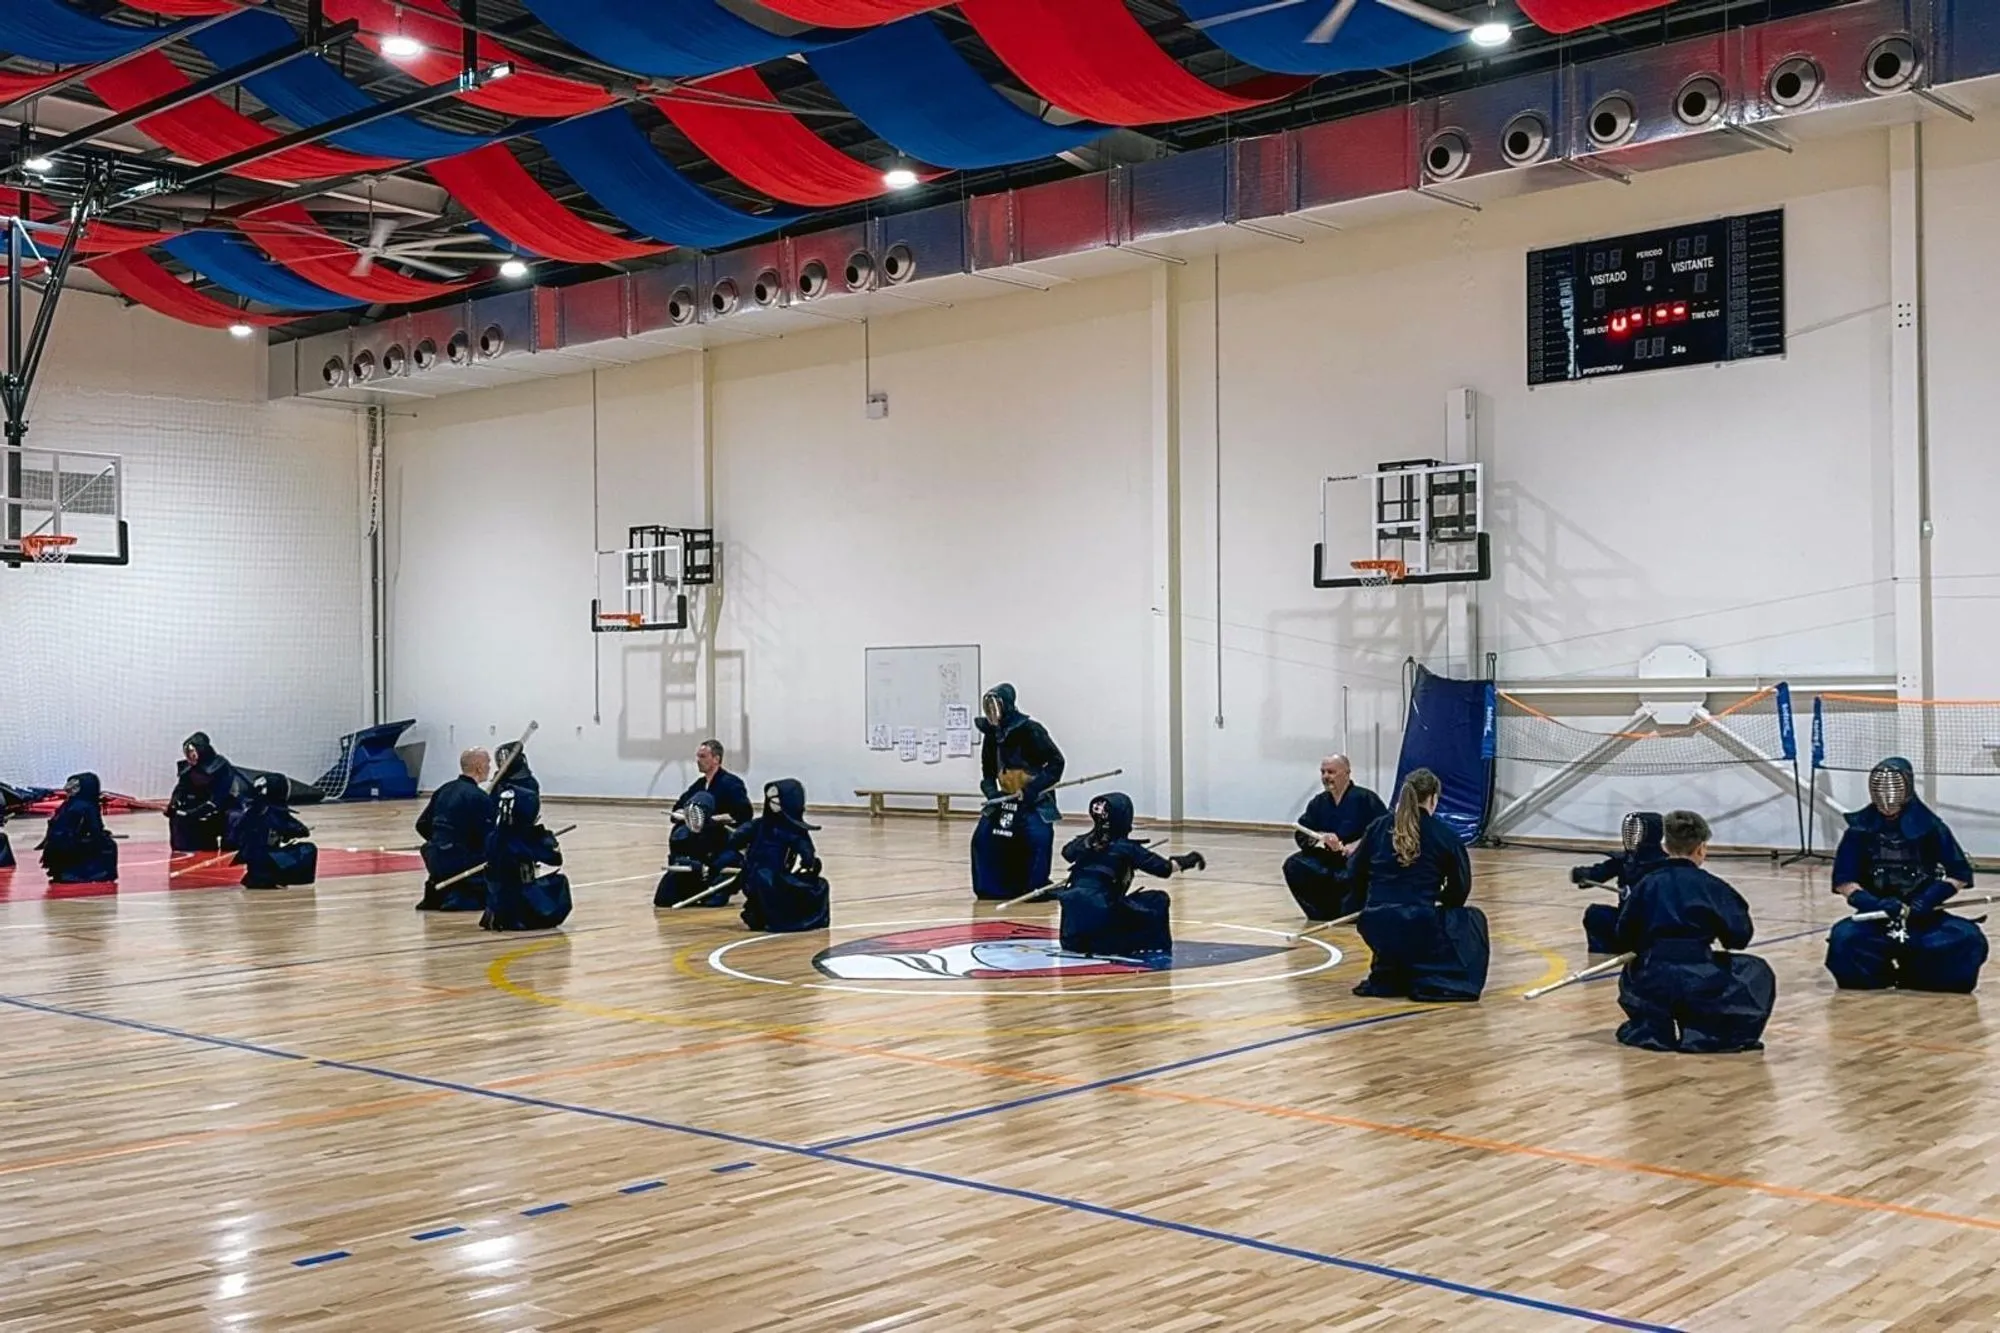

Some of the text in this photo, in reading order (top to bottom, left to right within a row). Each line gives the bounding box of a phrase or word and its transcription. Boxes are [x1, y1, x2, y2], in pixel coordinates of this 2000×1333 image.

[1636, 248, 1663, 259] PERIODO
[1671, 257, 1715, 273] VISITANTE
[1590, 271, 1628, 286] VISITADO
[1691, 309, 1720, 320] TIME OUT
